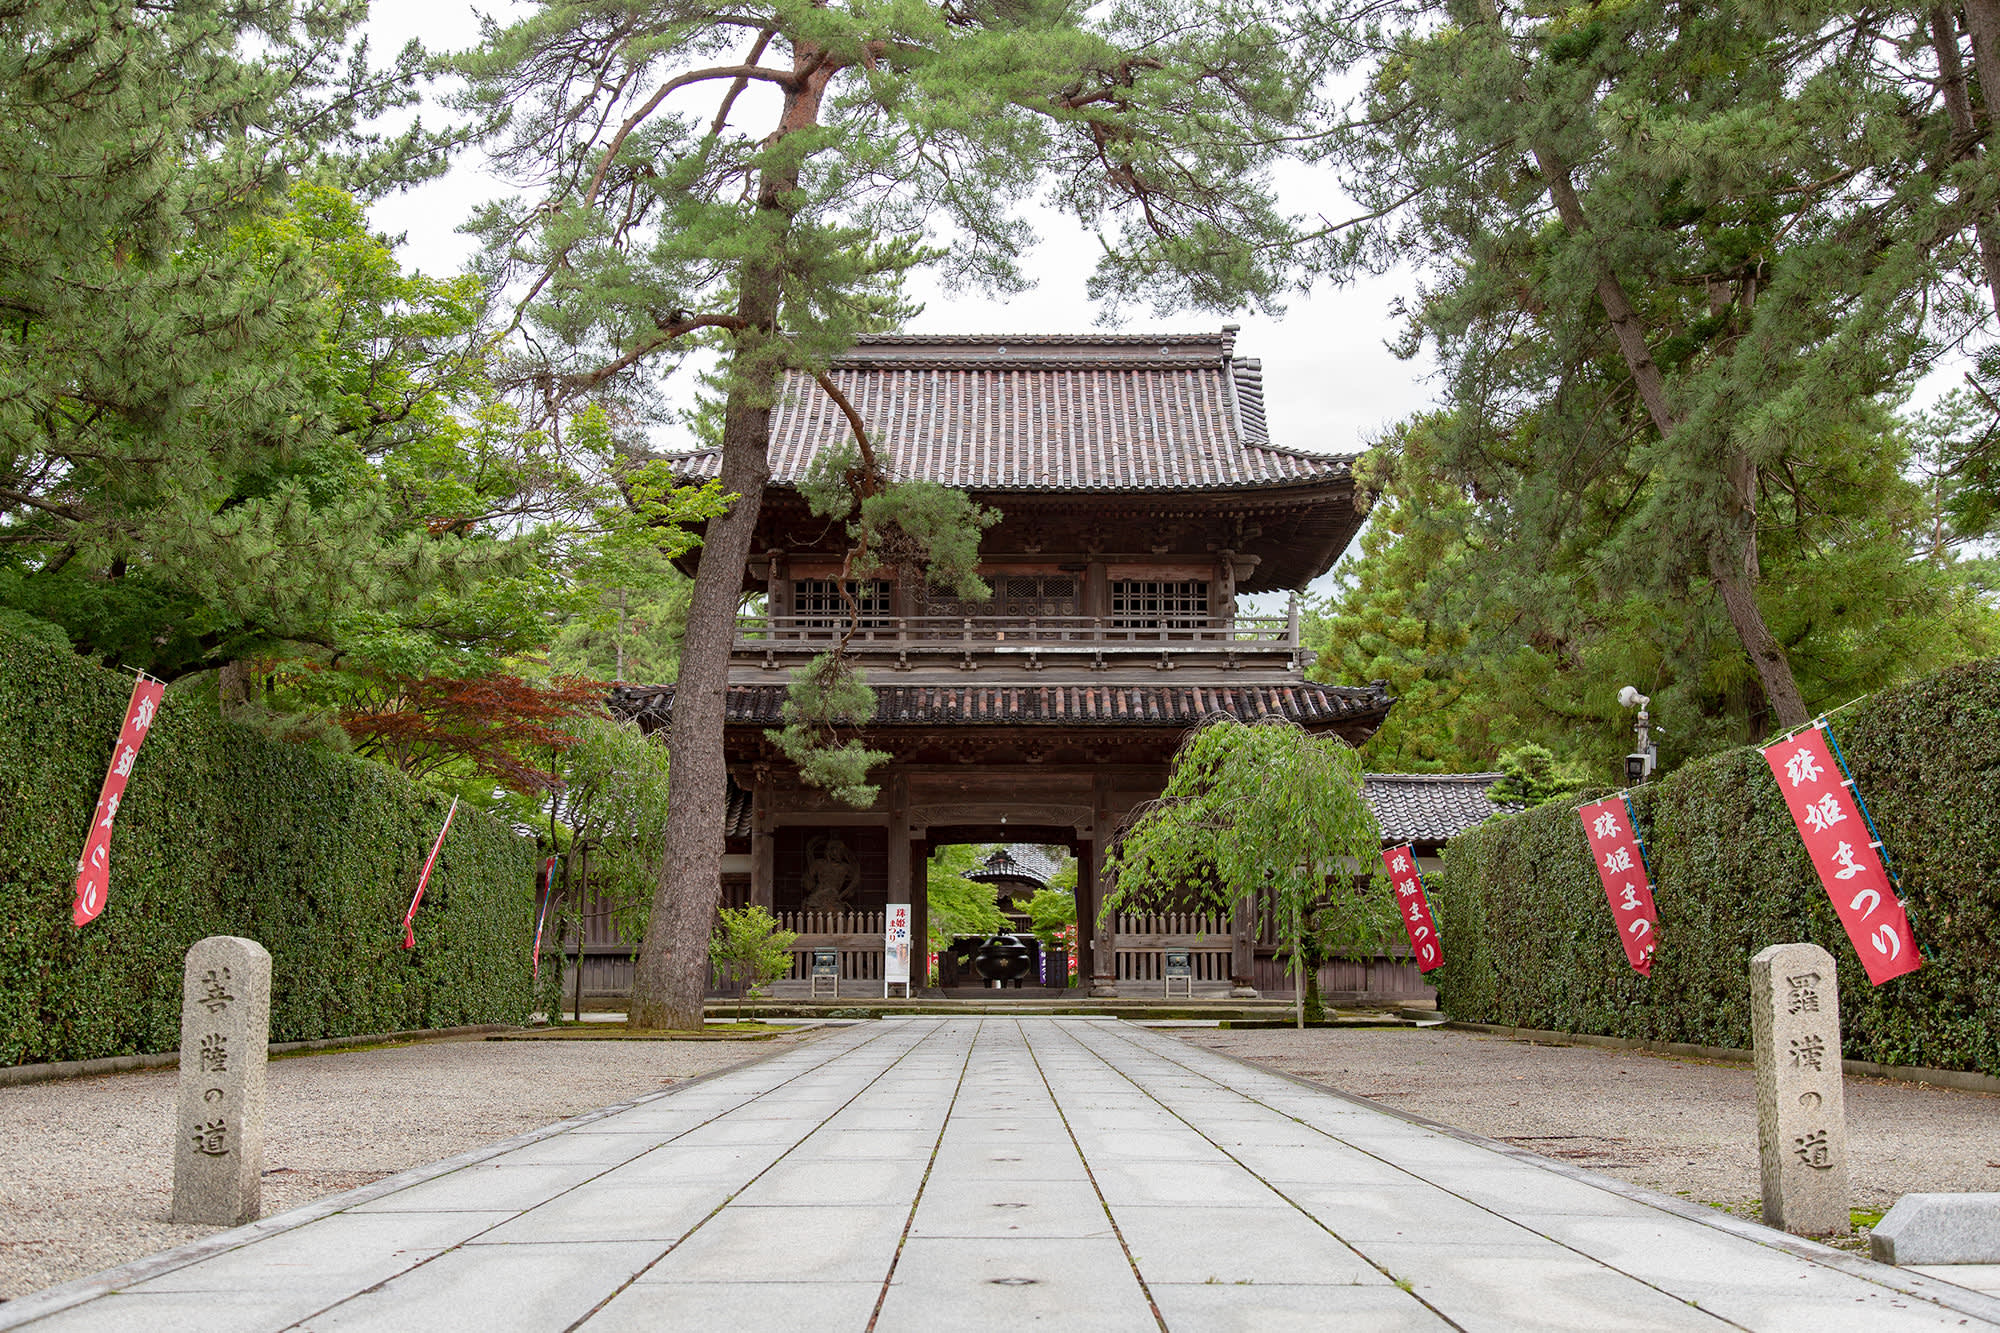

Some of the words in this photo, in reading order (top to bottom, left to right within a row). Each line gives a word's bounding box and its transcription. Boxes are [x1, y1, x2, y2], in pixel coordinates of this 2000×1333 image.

[1392, 854, 1435, 962] 珠姫まつり
[1785, 748, 1901, 961] 珠姫まつり
[192, 966, 235, 1158] 菩薩の道
[1786, 972, 1833, 1170] 羅漢の道
